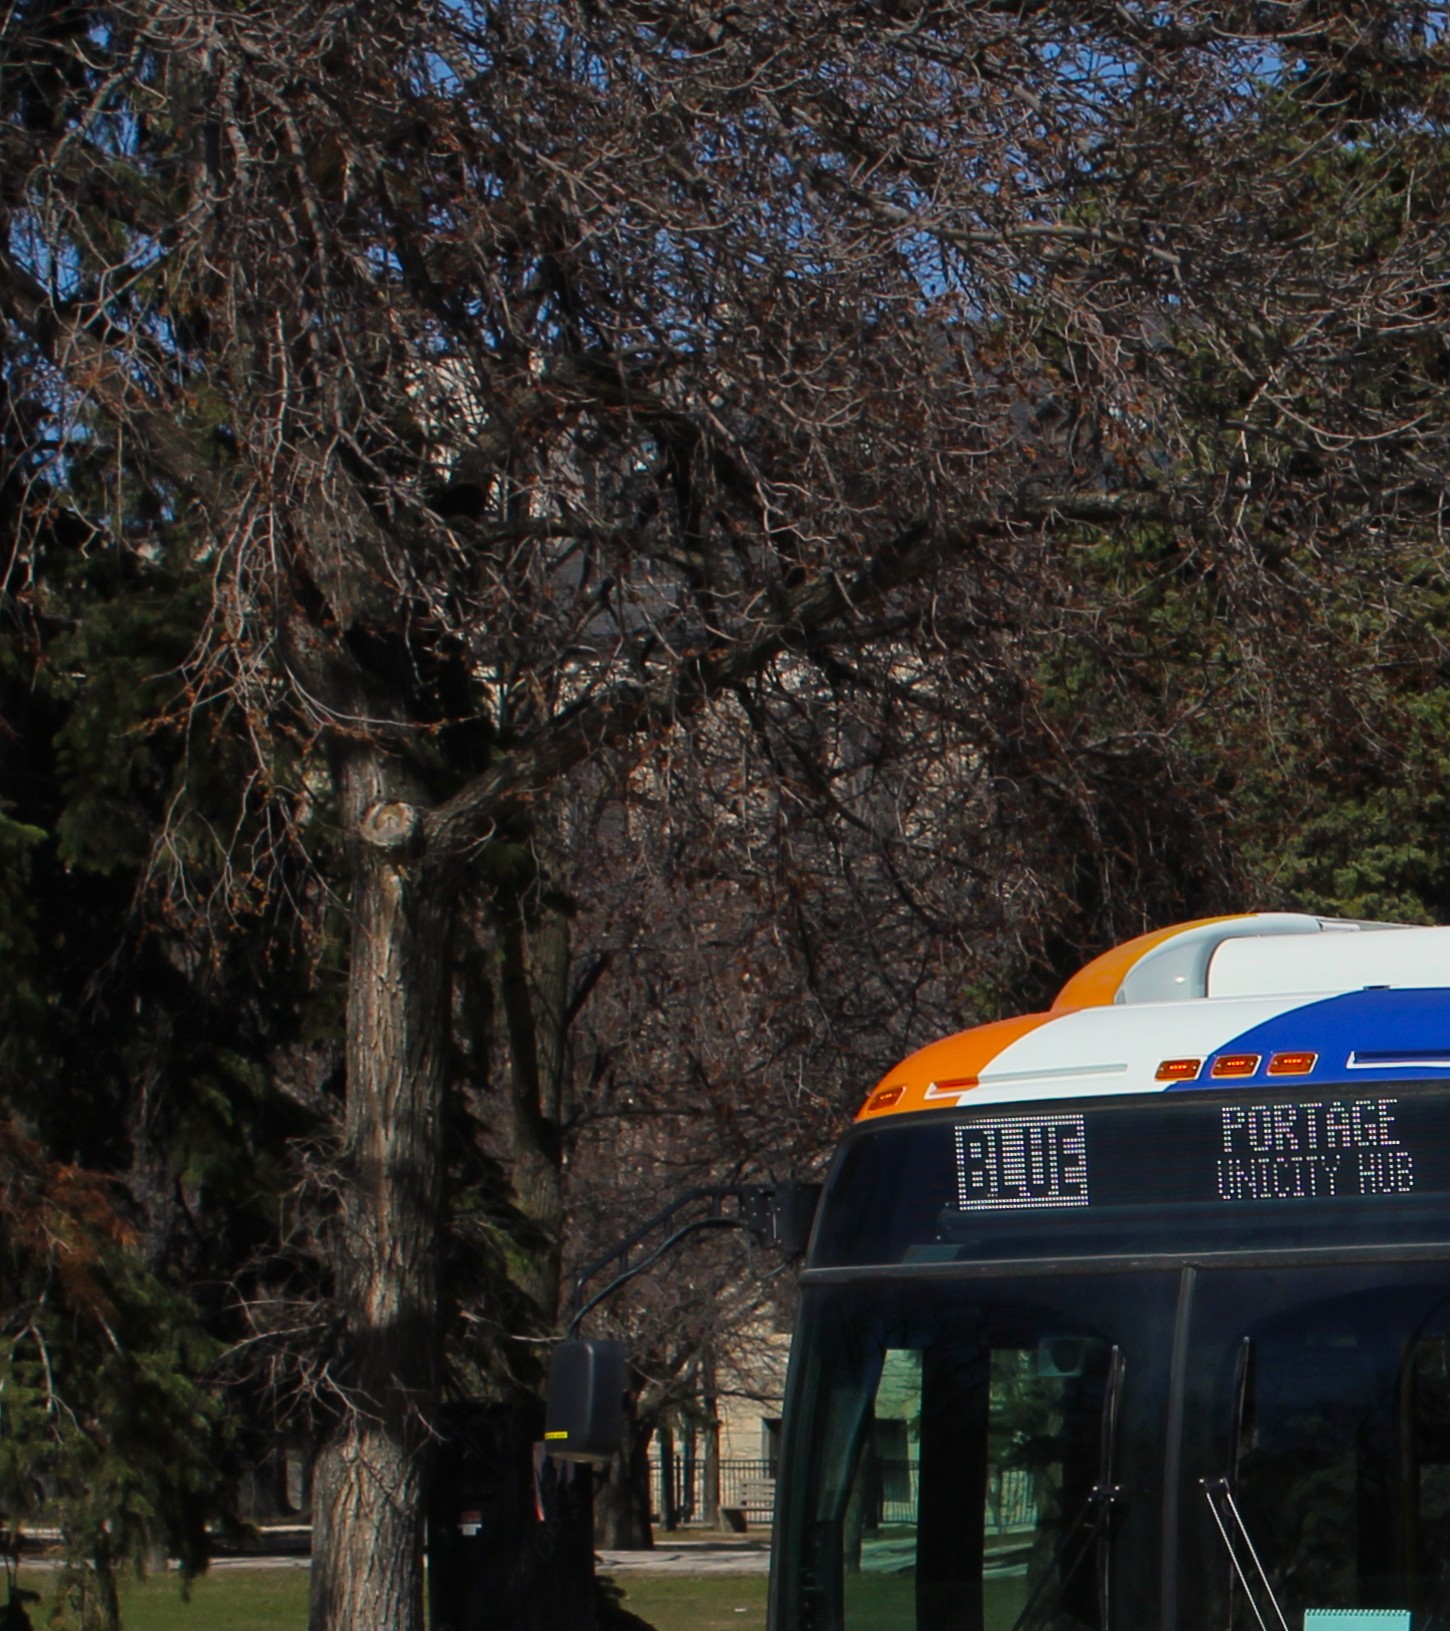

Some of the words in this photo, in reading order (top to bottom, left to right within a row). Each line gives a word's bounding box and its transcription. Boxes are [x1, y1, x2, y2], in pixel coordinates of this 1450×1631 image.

[1221, 1098, 1401, 1153] PORTAGE
[960, 1121, 1086, 1200] BLUE
[1217, 1154, 1341, 1201] UNICITY
[1358, 1151, 1414, 1194] HUB
